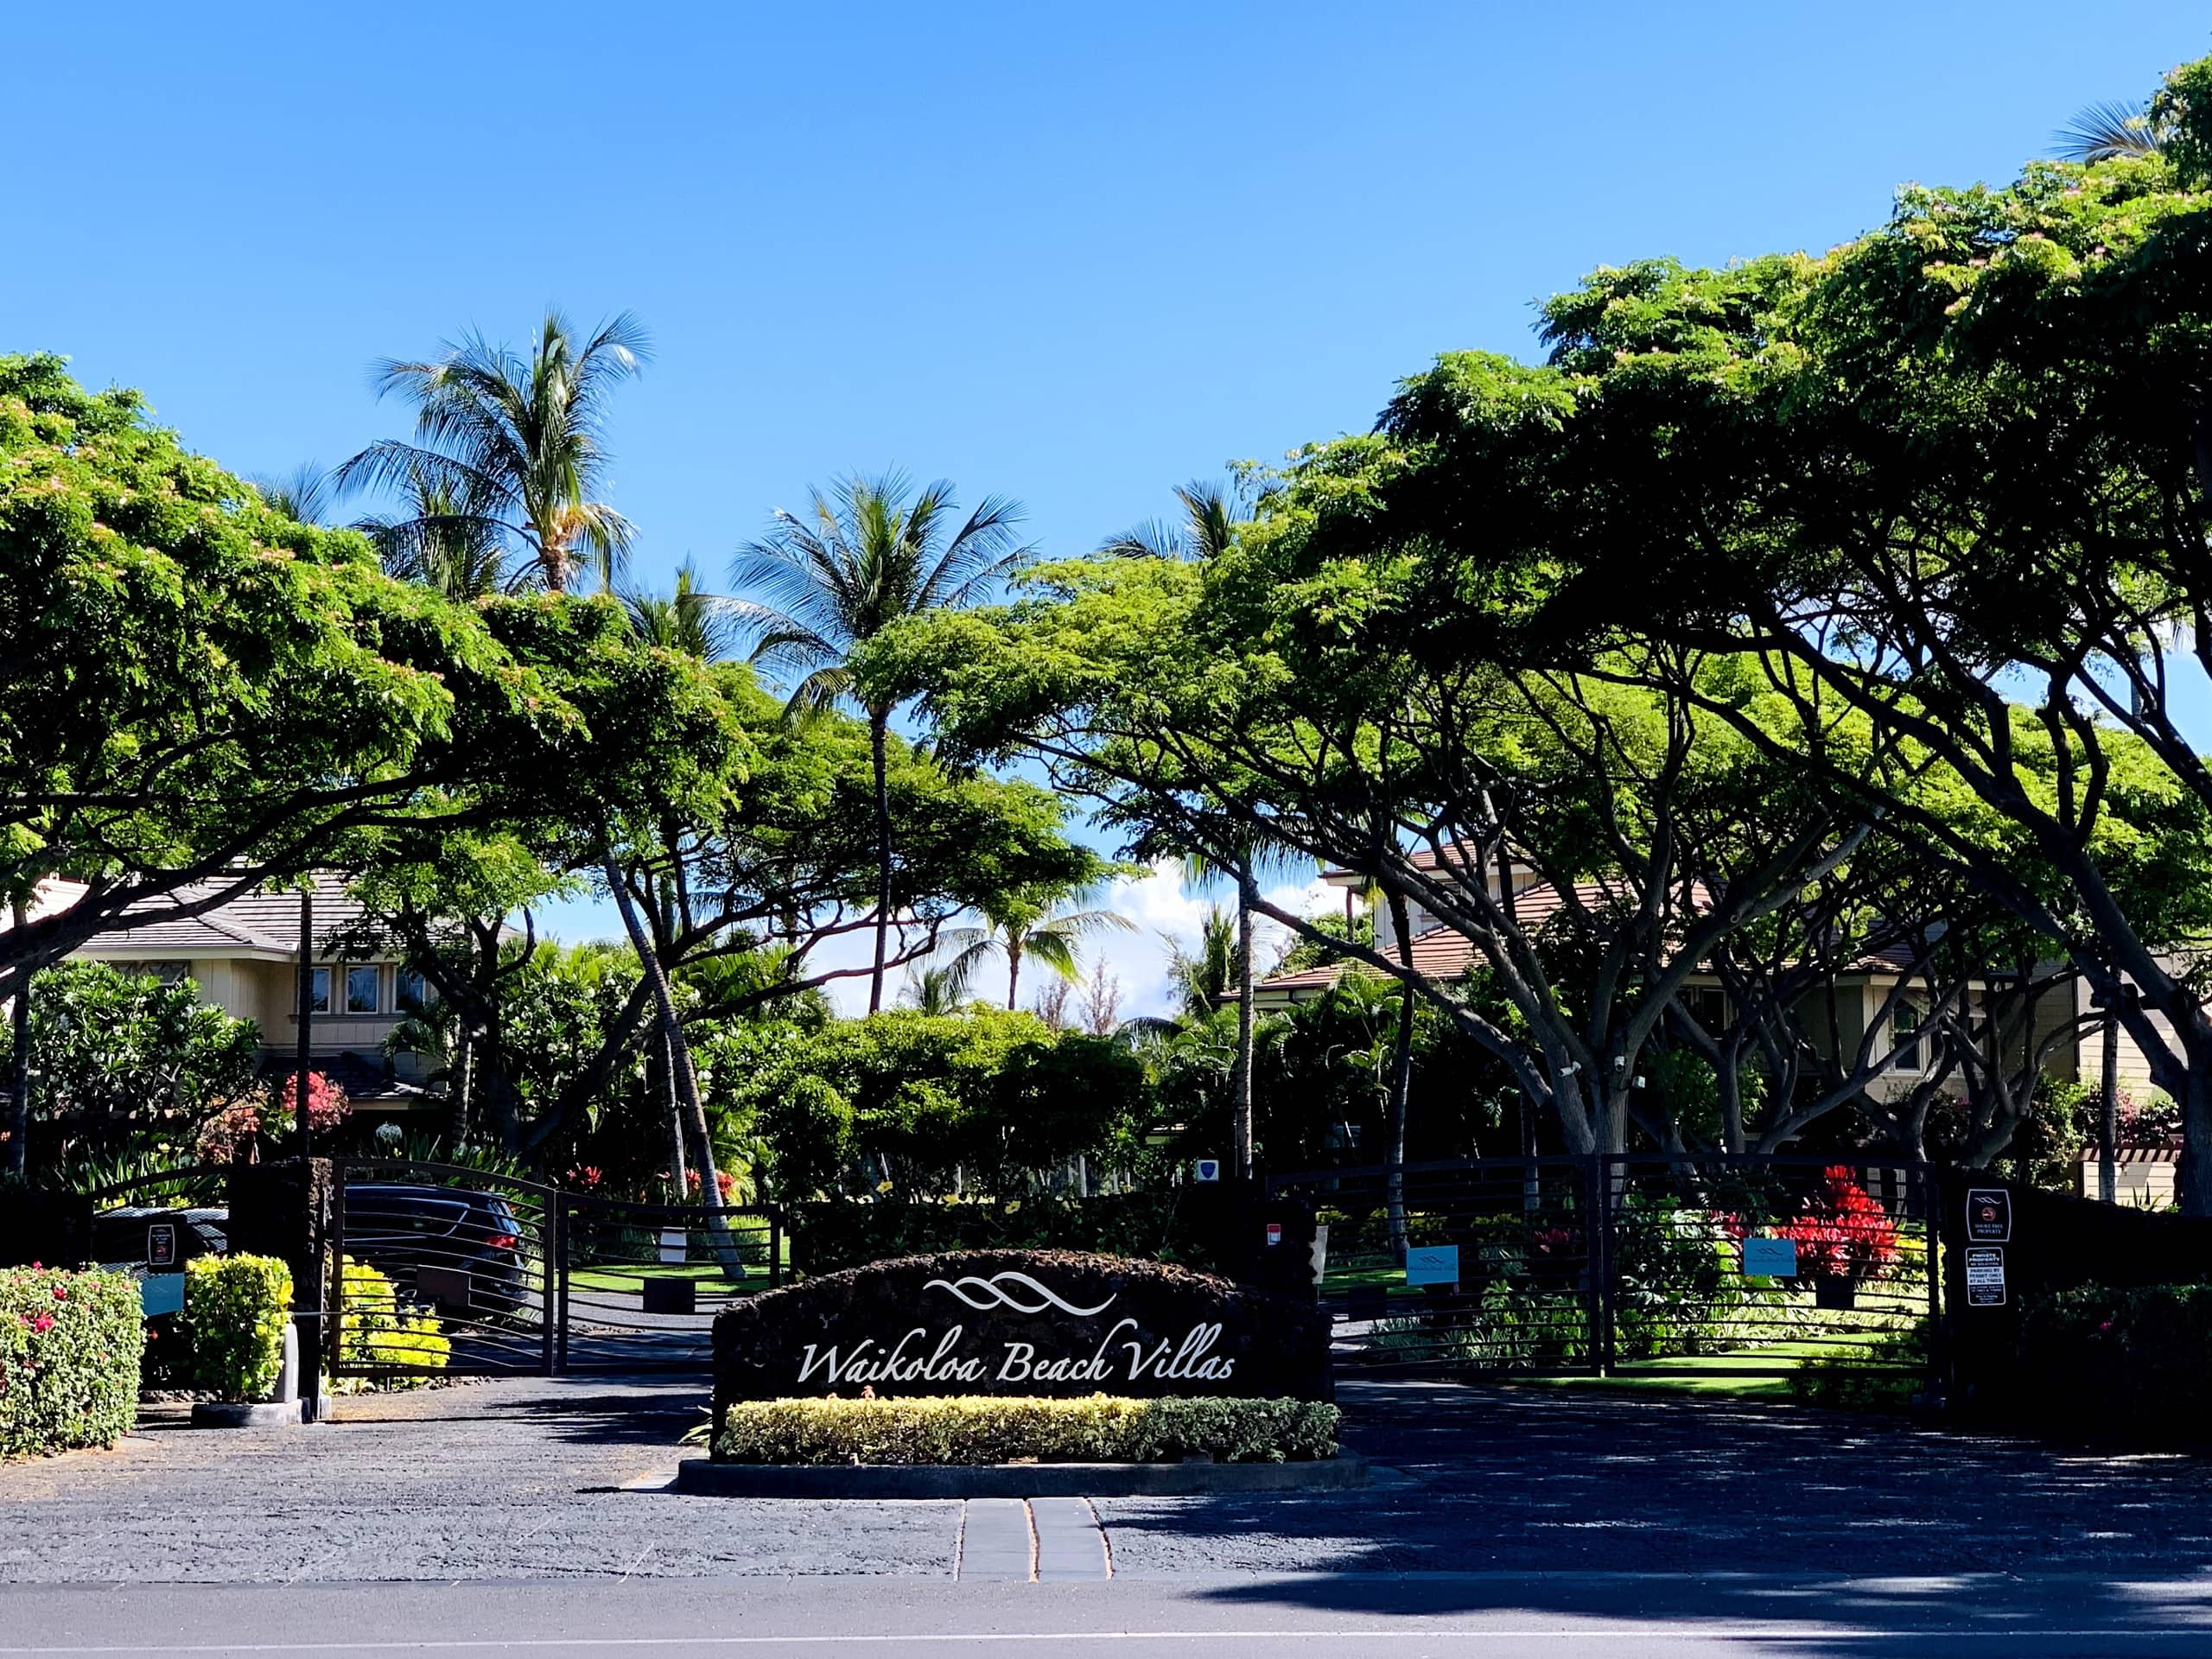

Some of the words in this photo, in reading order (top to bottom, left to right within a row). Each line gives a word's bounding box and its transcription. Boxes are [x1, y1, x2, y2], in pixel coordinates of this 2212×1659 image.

[798, 1325, 987, 1382] Waikoloa
[996, 1319, 1137, 1381] Beach
[1122, 1323, 1235, 1380] Villas
